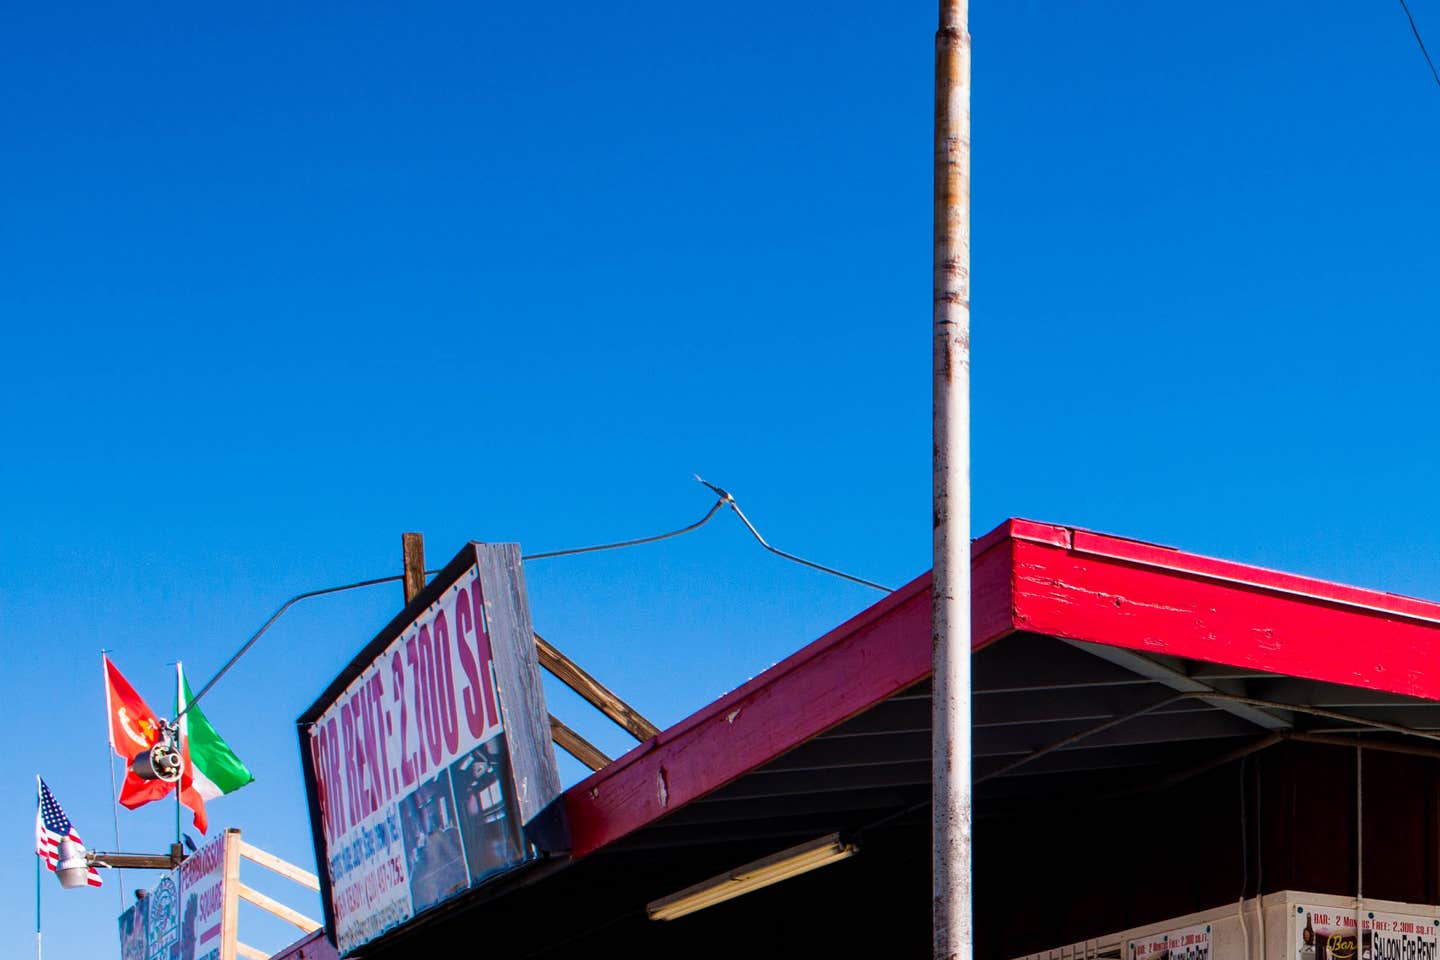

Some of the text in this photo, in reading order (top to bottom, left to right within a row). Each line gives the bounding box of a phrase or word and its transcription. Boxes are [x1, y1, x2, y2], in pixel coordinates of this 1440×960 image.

[341, 669, 400, 828] RENT:
[391, 608, 459, 788] 2,700
[456, 578, 499, 740] SF
[1332, 936, 1357, 951] Bar
